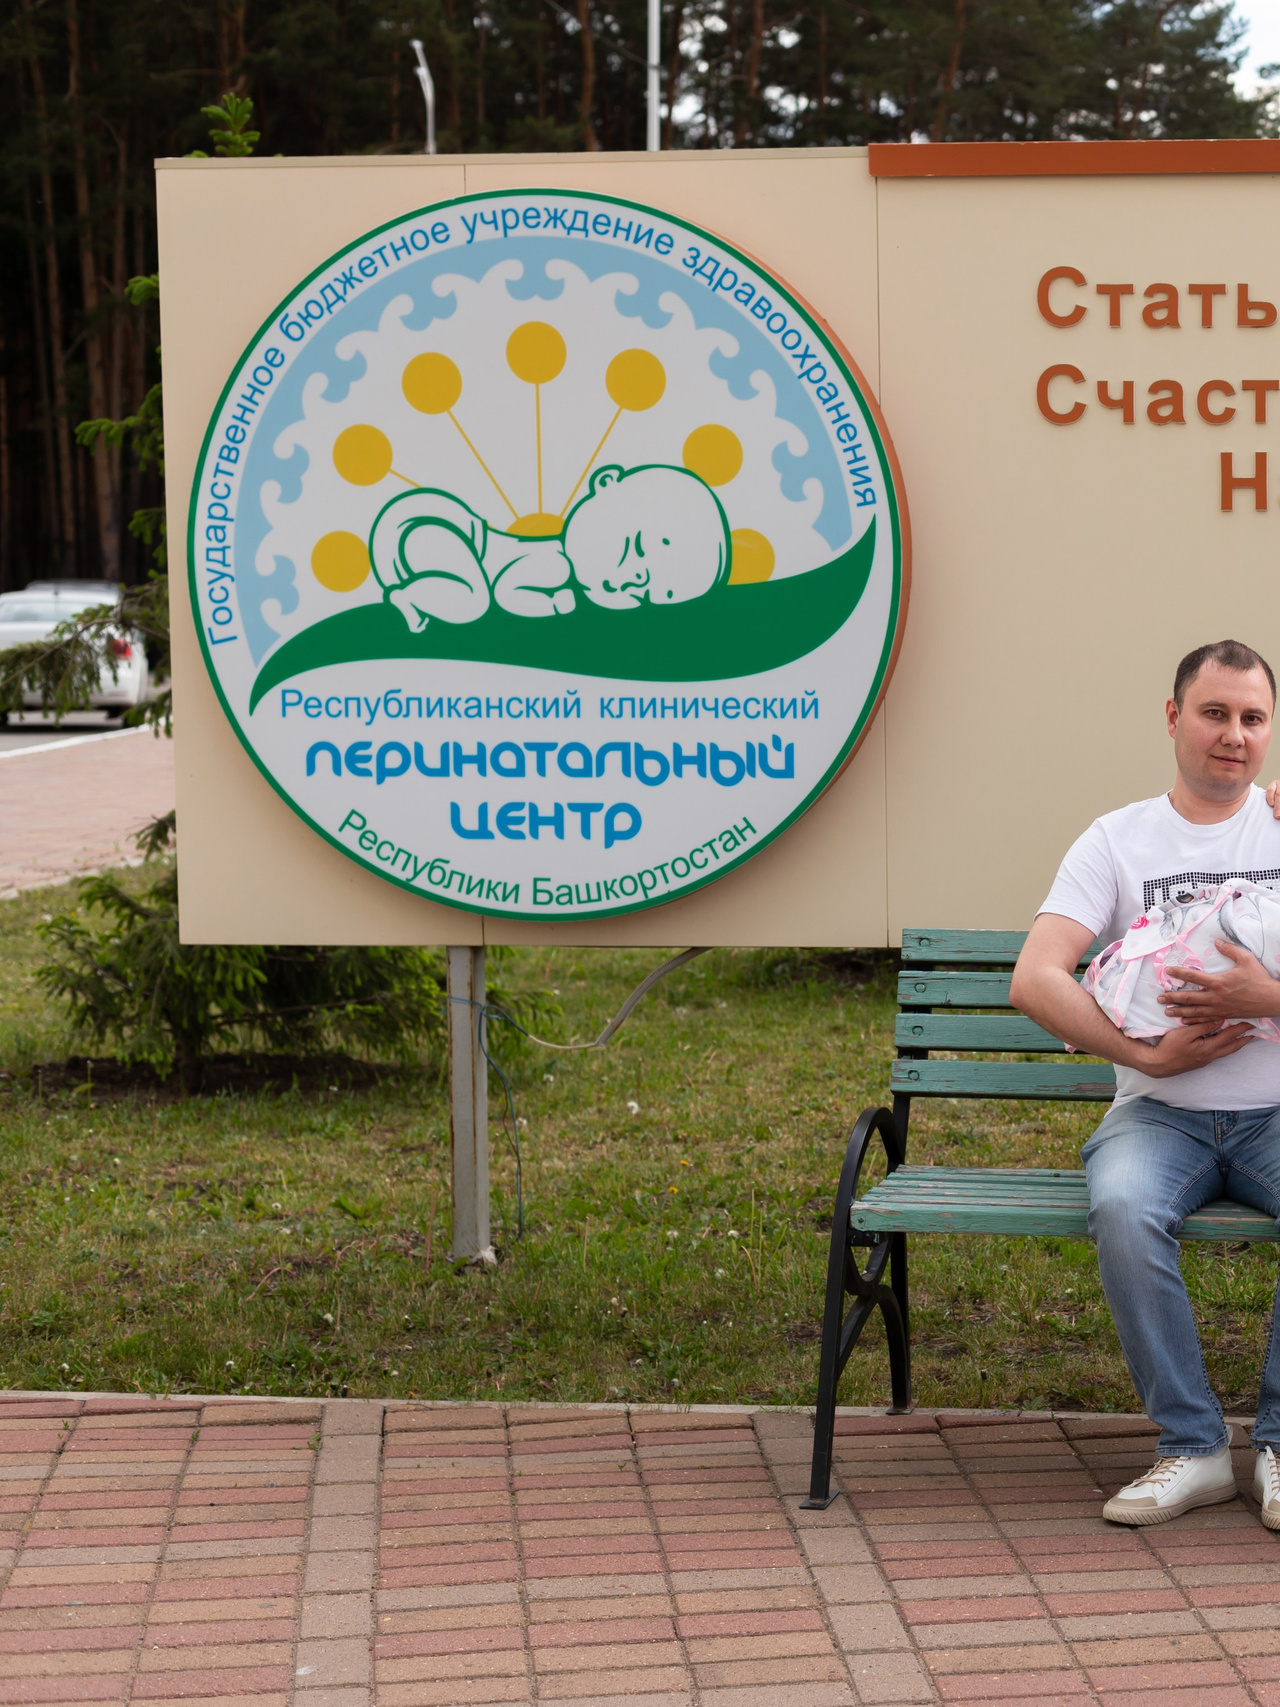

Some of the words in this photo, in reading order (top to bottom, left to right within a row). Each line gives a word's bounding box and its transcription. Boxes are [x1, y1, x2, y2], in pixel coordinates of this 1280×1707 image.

[1036, 265, 1278, 329] Стать
[205, 347, 286, 646] Государственное
[279, 221, 451, 342] бюджетное
[460, 206, 675, 256] учреждение
[682, 246, 878, 509] здравоохранения
[281, 688, 581, 726] Республиканский
[599, 690, 819, 719] клинический
[338, 808, 520, 904] Республики
[532, 816, 757, 906] Башкортостан
